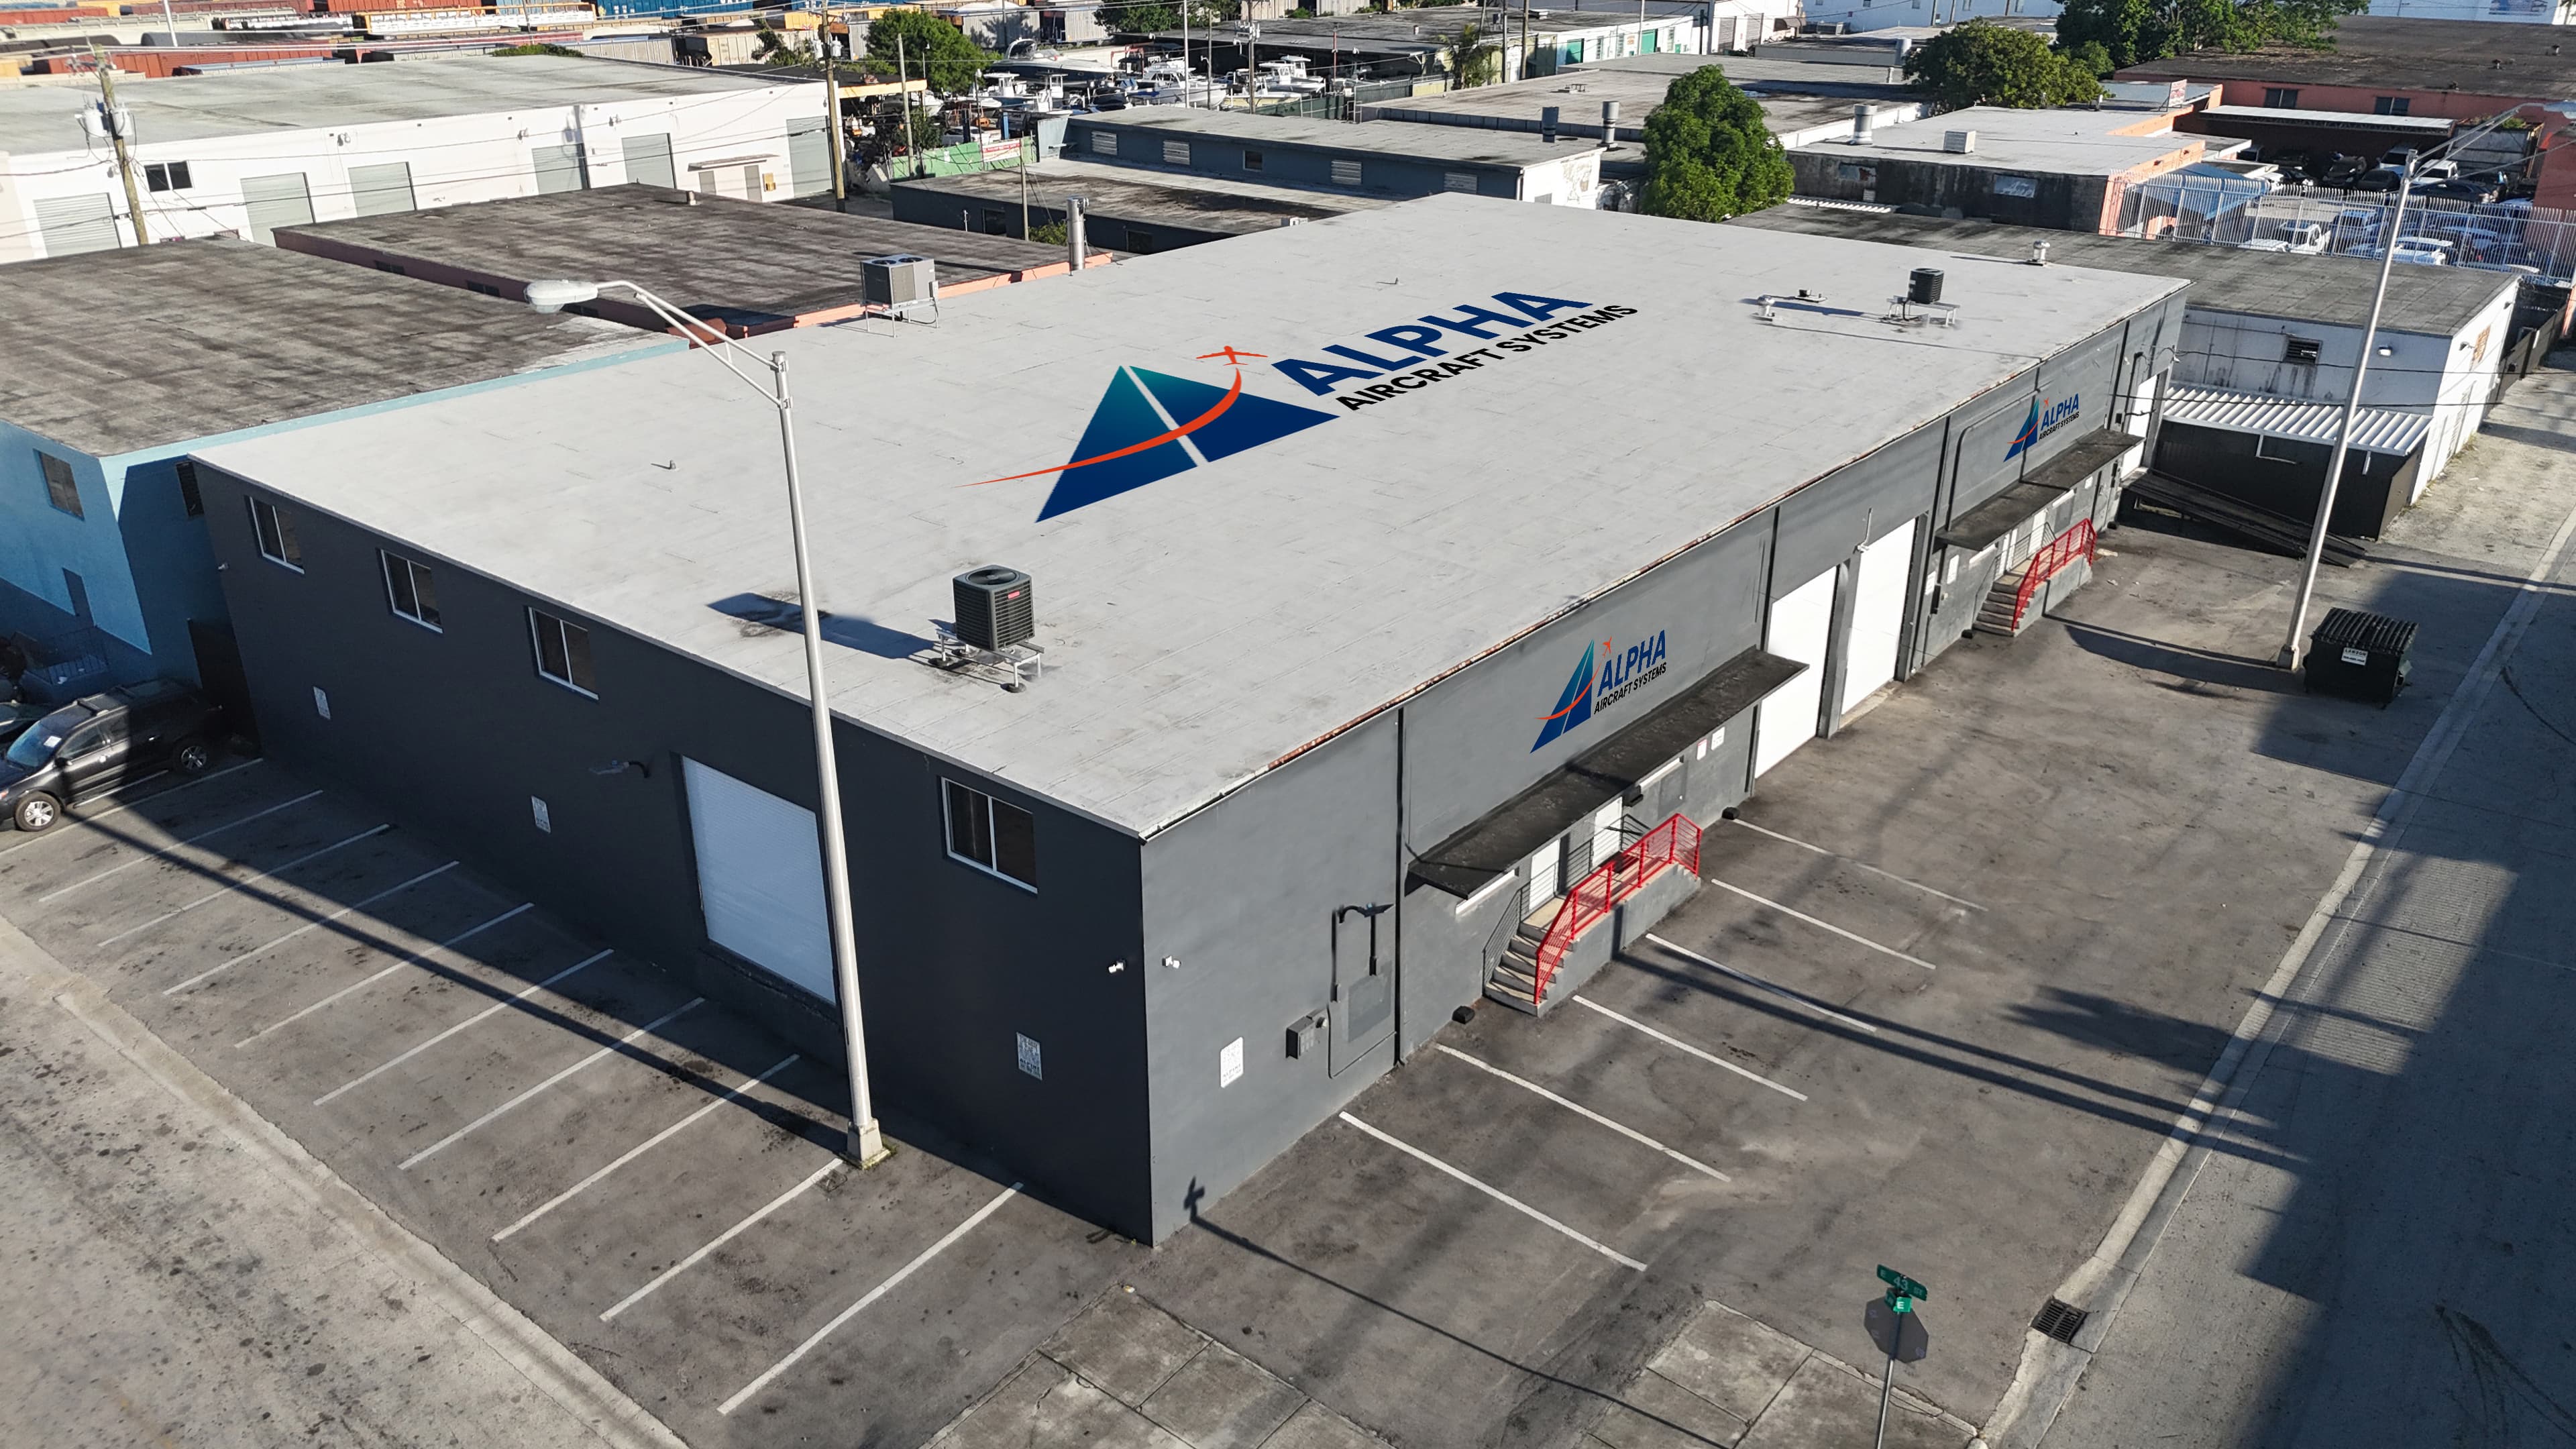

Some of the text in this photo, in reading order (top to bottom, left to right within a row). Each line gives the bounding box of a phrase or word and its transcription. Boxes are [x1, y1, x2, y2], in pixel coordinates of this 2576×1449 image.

[1273, 291, 1592, 396] ALPHA
[1335, 305, 1638, 411] AIRCRAFT SYSTEMS
[2039, 411, 2080, 441] AIRCRAFT SYSTEMS
[2041, 394, 2079, 430] ALPHA
[1597, 630, 1666, 697] ALPHA
[1593, 662, 1667, 715] AIRCRAFT SYSTEMS
[1893, 1276, 1909, 1291] 43
[1896, 1301, 1904, 1309] E
